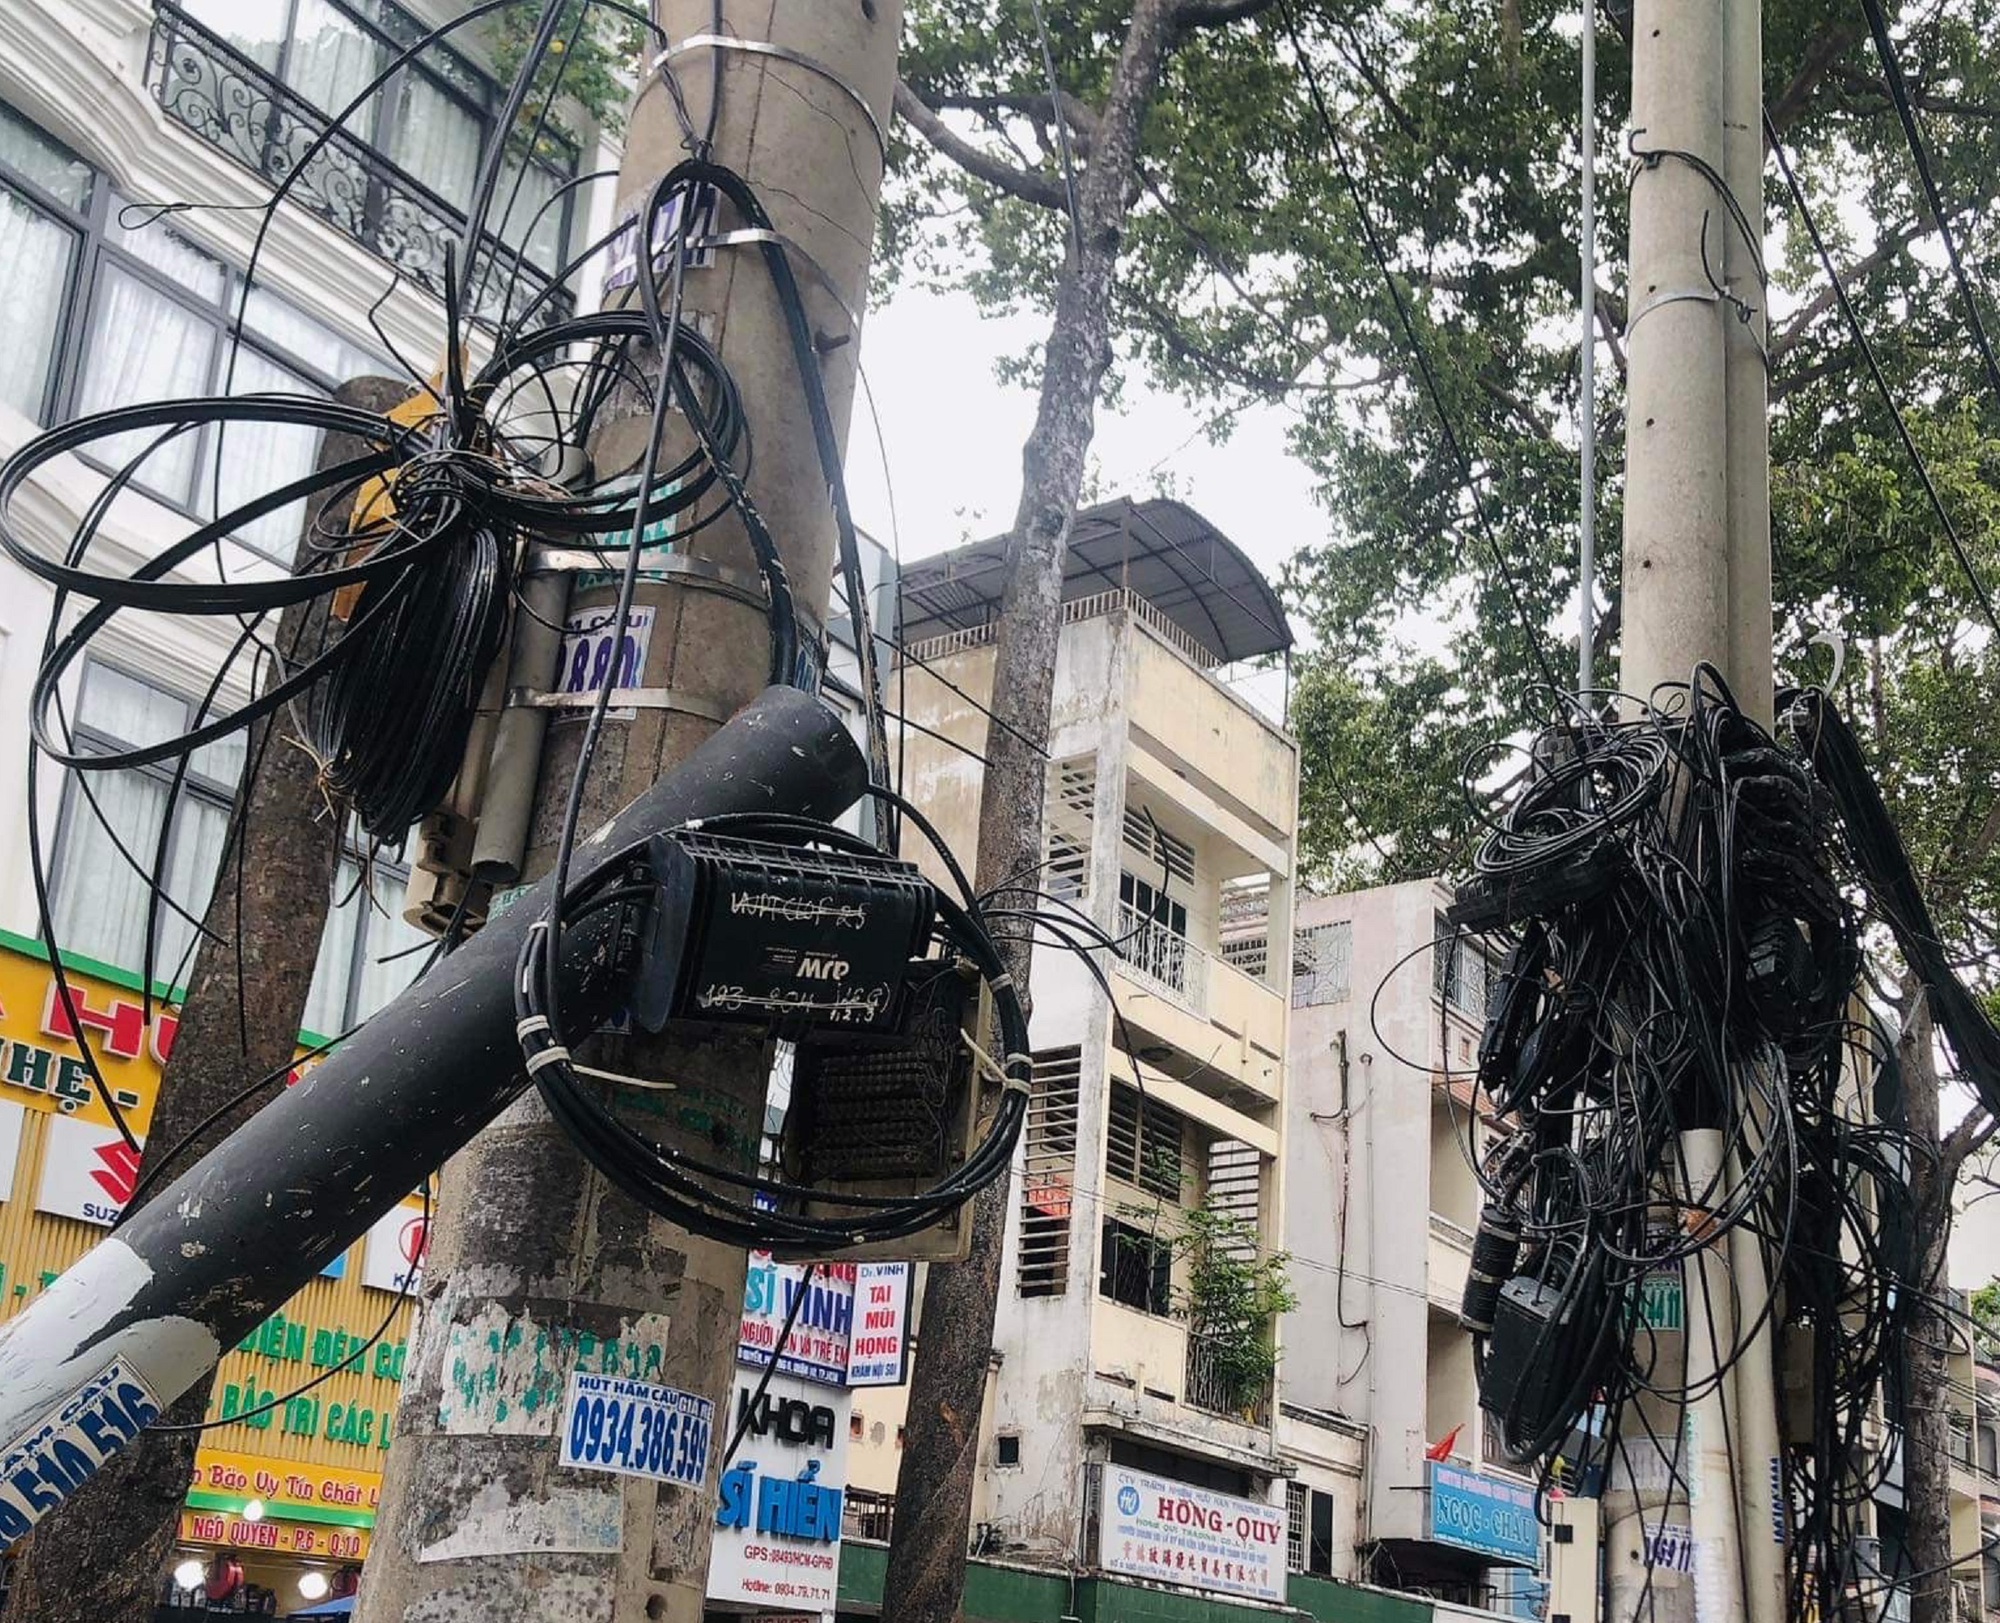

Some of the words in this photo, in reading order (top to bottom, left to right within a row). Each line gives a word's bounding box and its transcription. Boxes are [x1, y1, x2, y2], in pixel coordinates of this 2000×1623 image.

[785, 1277, 853, 1335] VINH
[870, 1285, 891, 1304] TAI
[865, 1307, 895, 1329] MŨI
[835, 1345, 849, 1364] EM
[855, 1336, 897, 1359] HỌNG
[738, 1388, 836, 1449] KHOA
[570, 1395, 708, 1483] 0934.386.599
